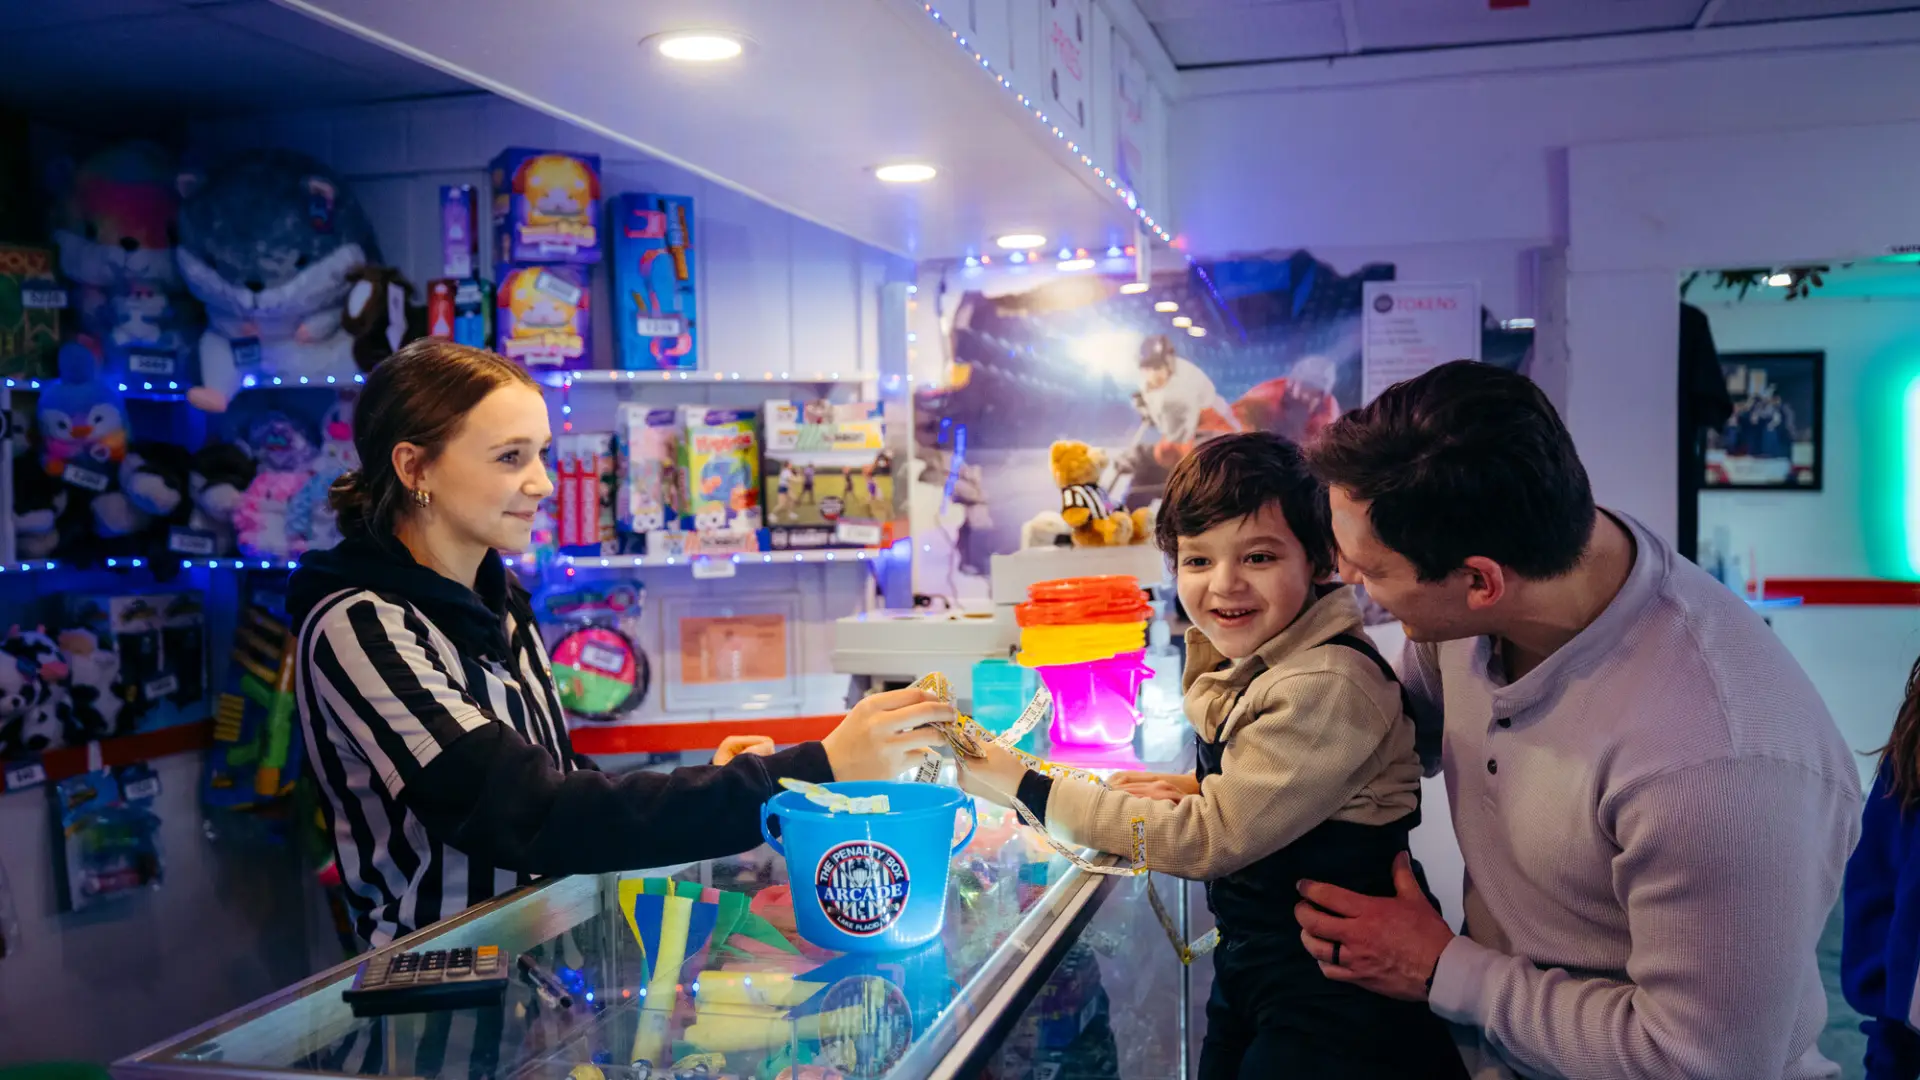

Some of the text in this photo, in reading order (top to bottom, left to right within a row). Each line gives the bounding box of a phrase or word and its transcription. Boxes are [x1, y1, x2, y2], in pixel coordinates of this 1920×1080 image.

[1397, 296, 1457, 312] TOKENS
[820, 846, 904, 882] THE PENALTY BOX
[824, 883, 903, 901] ARCADE
[836, 915, 854, 929] LAKE
